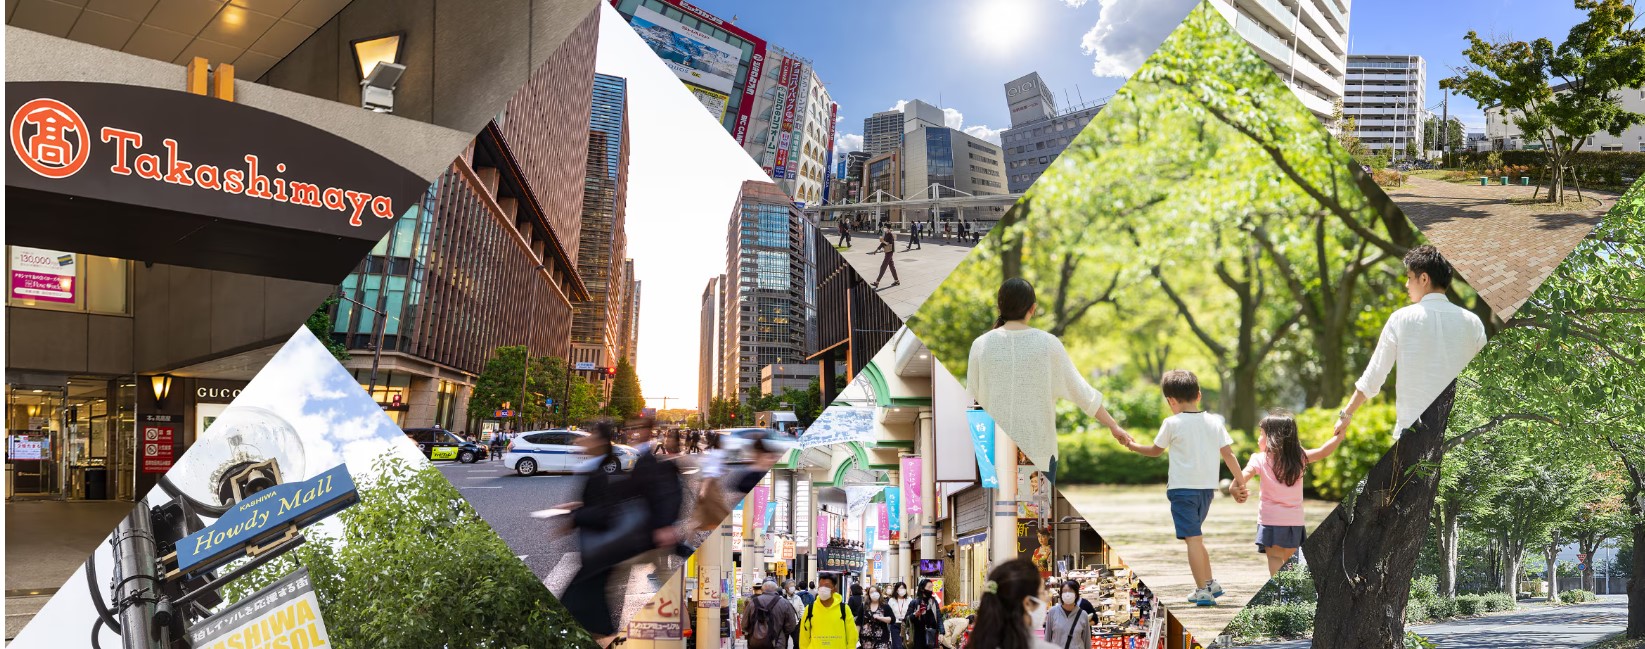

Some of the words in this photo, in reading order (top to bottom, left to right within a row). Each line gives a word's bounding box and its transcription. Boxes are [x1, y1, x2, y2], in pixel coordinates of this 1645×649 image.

[101, 126, 394, 226] Takashimaya
[20, 254, 51, 265] 130,000
[192, 508, 270, 556] Howdy
[277, 475, 333, 516] Mall
[239, 490, 277, 512] KASHIWA
